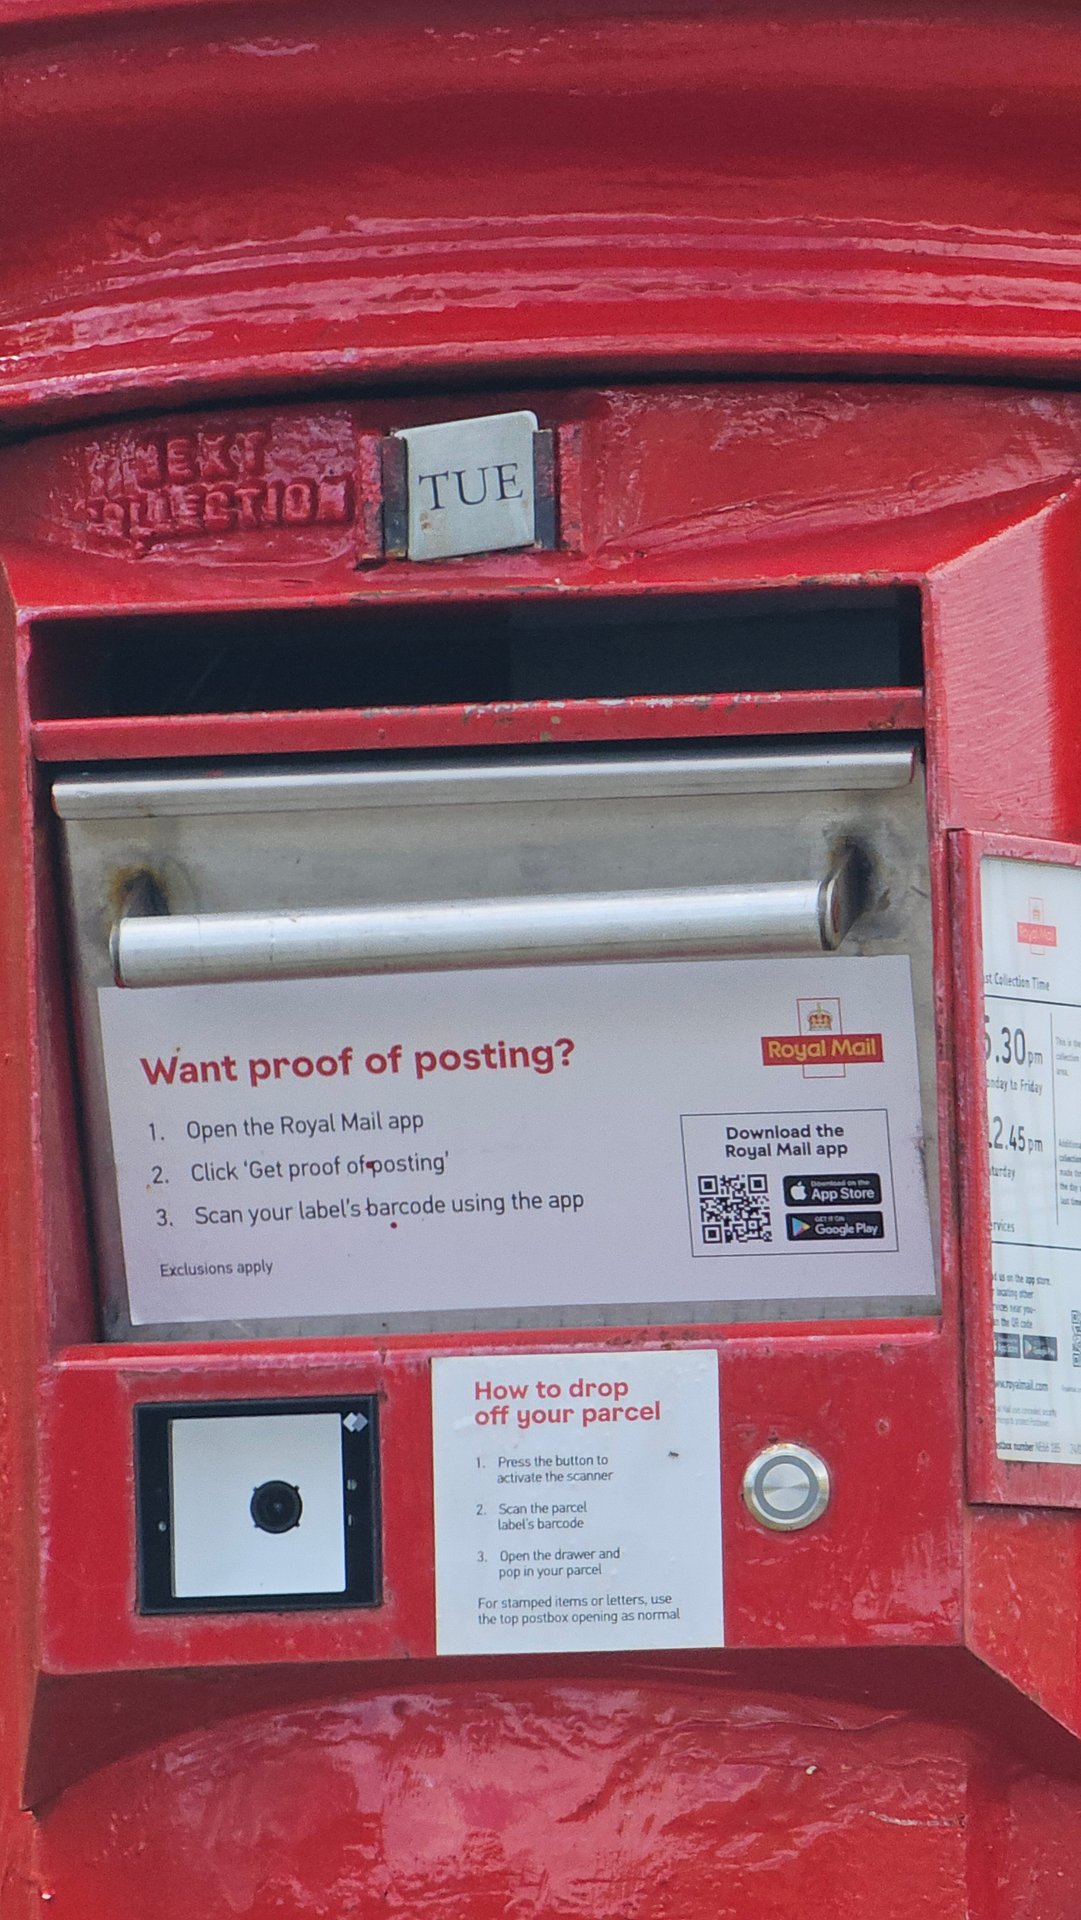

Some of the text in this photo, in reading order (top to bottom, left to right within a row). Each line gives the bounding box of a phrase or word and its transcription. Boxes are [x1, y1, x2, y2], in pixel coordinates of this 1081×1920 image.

[136, 430, 266, 482] NEXT
[418, 462, 524, 510] TUE
[995, 973, 1030, 988] Collection
[1032, 976, 1050, 991] Time
[767, 1037, 877, 1061] Royal Mail
[140, 1038, 575, 1087] Want proof of posting?
[985, 1077, 1043, 1096] onday to Friday
[149, 1110, 424, 1143] 1. Open the Royal Mail app
[725, 1122, 845, 1141] Download the
[988, 1115, 1043, 1155] 2.45pm
[725, 1141, 849, 1161] Royal Mail app
[151, 1165, 169, 1184] 2.
[191, 1161, 239, 1182] Click
[289, 1155, 341, 1182] proof
[347, 1154, 365, 1174] of
[989, 1165, 1016, 1181] turday
[811, 1187, 875, 1202] App Store
[156, 1189, 585, 1227] 3. Scan your label's barcode using the app
[815, 1222, 879, 1237] Google Play
[990, 1218, 1015, 1233] rvices
[160, 1258, 274, 1278] Exclusions apply
[475, 1377, 629, 1401] How to drop
[475, 1400, 661, 1430] off your parcel
[476, 1455, 609, 1469] 1. Press the button to
[497, 1471, 614, 1484] activate the scanner
[476, 1501, 588, 1517] 2. Scan the parcel
[498, 1517, 585, 1531] label's barcode
[477, 1547, 621, 1564] 3. Open the drawer and
[499, 1563, 602, 1580] pop in your parcel
[478, 1594, 673, 1612] For stamped items or letters, use
[478, 1608, 681, 1626] the top postbox opening as normal
